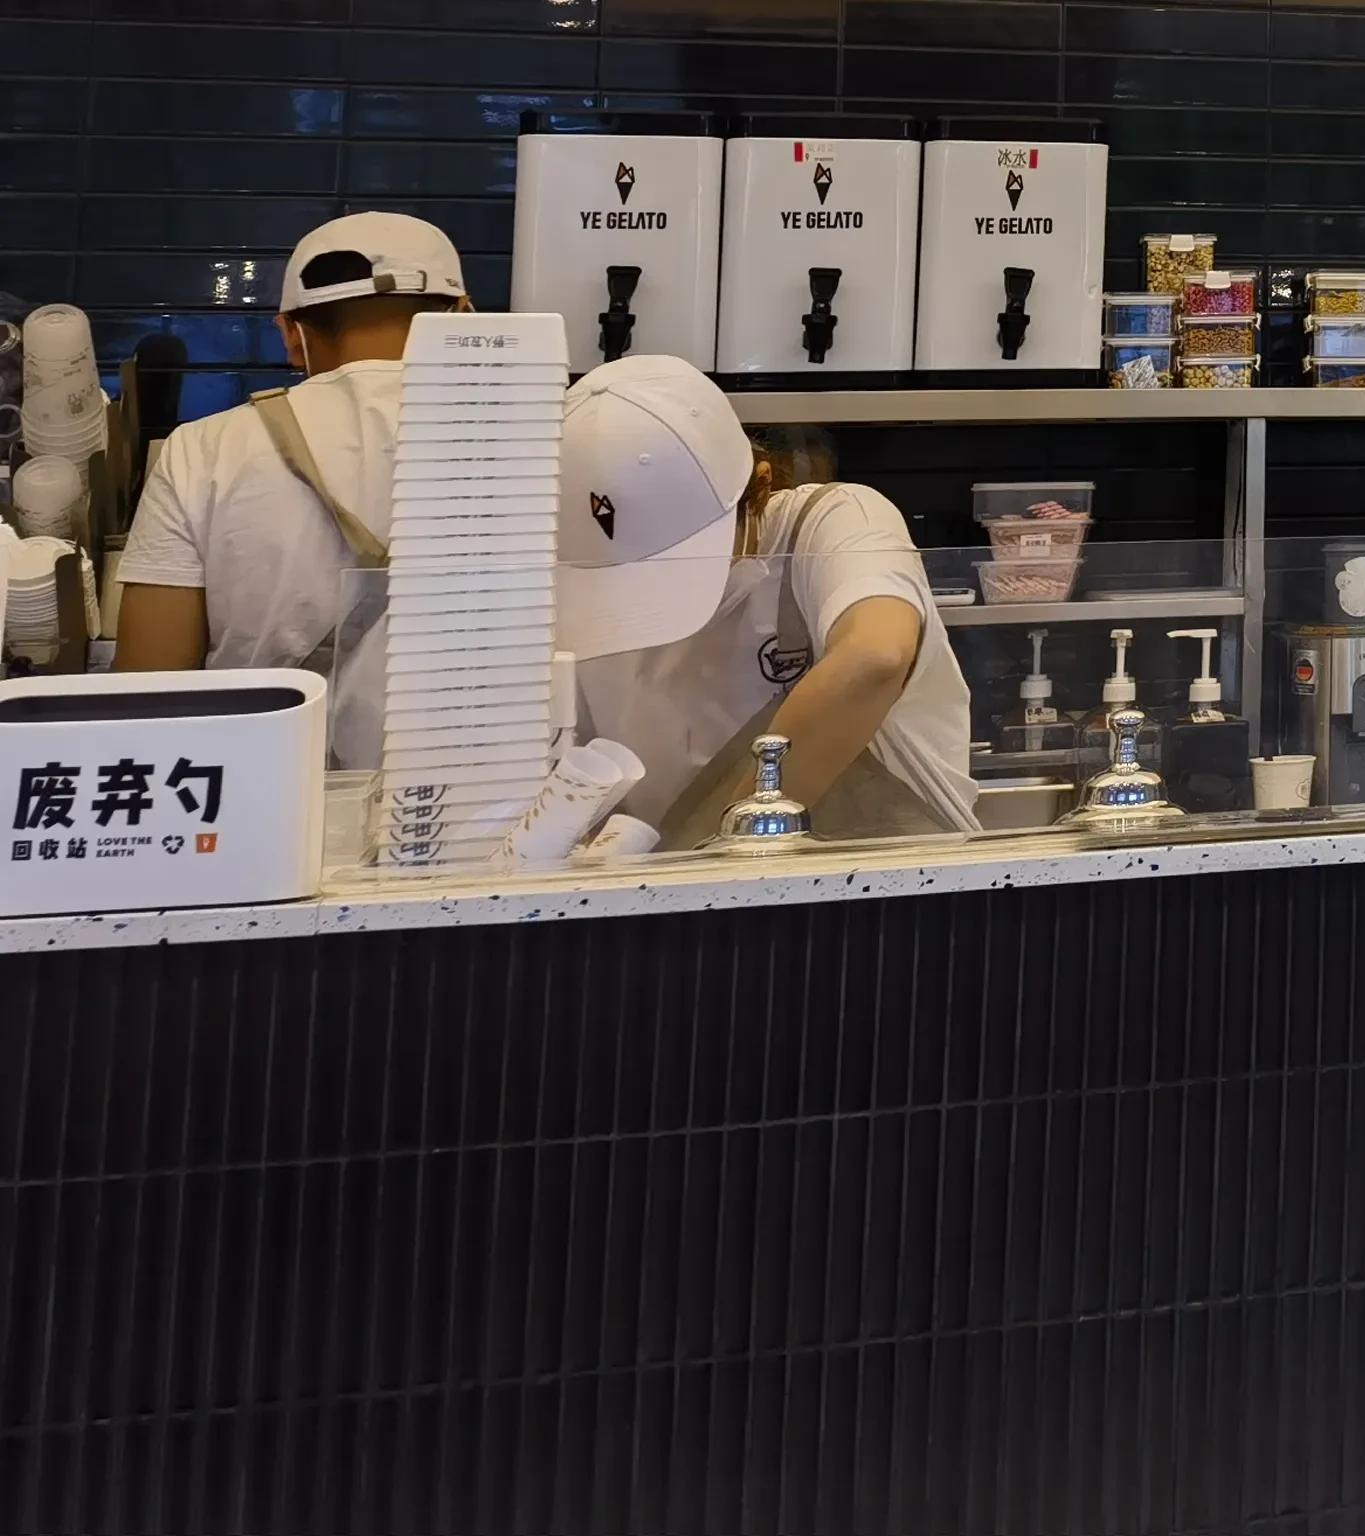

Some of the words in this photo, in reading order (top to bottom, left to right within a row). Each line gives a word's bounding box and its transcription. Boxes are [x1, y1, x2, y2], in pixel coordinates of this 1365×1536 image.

[580, 211, 601, 230] YE
[606, 211, 667, 231] GELATO
[781, 212, 801, 229] YE
[806, 211, 863, 229] GELATO
[975, 218, 994, 235] YE
[999, 217, 1053, 234] GELATO
[12, 757, 224, 829] 废弃勺
[11, 837, 88, 861] 回收站
[97, 837, 128, 847] LOVE
[130, 836, 153, 846] THE
[97, 848, 135, 858] EARTH
